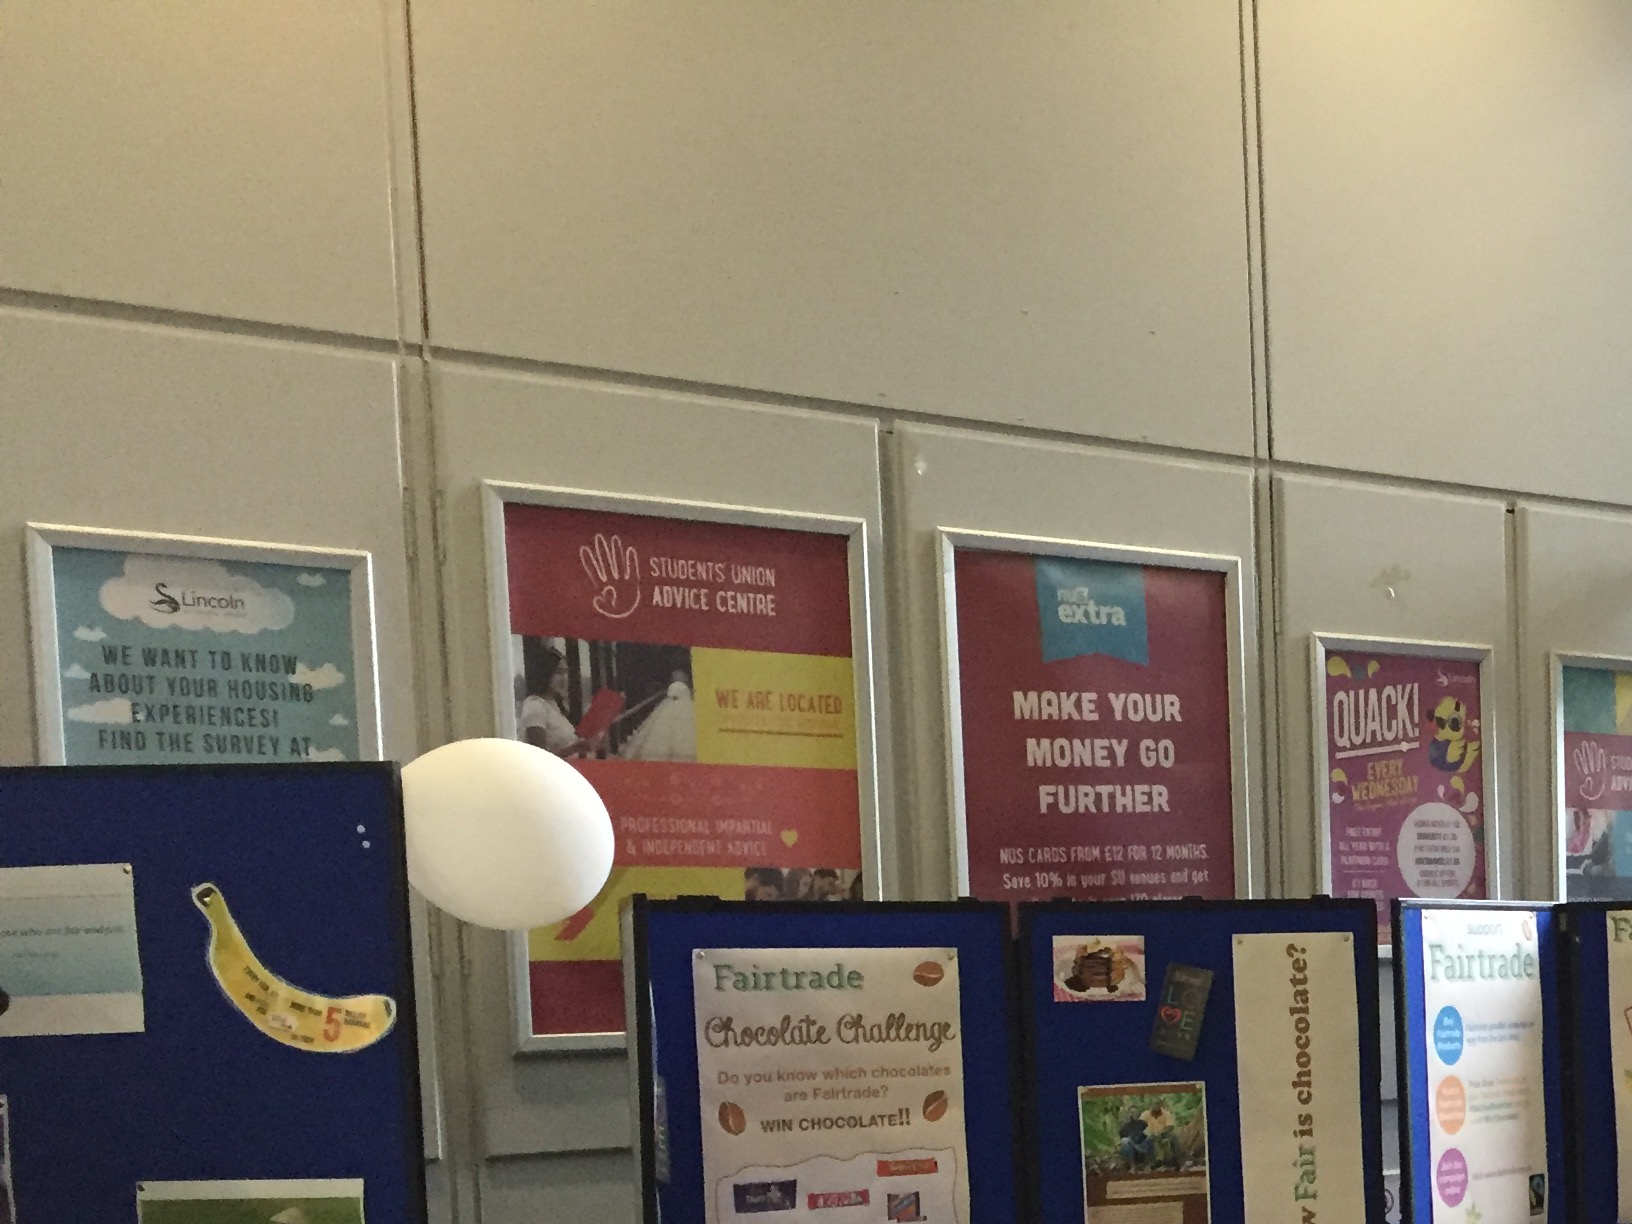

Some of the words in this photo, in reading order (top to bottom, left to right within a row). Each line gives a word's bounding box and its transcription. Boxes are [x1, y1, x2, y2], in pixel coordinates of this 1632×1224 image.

[731, 567, 776, 588] UNION
[181, 591, 245, 610] Lincoln
[652, 585, 710, 611] ADVICE
[716, 591, 776, 616] CENTRE
[1058, 602, 1127, 627] extra
[102, 645, 132, 665] WE
[142, 647, 198, 669] WANT
[208, 651, 232, 671] TO
[241, 652, 298, 675] KNOW
[89, 672, 156, 696] ABOUT
[167, 677, 218, 698] YOUR
[228, 679, 314, 703] HOUSING
[131, 702, 279, 728] EXPERIENCES!
[715, 689, 739, 710] WE
[749, 690, 773, 711] ARE
[779, 692, 844, 715] LOCATED
[1012, 690, 1099, 722] MAKE
[1108, 692, 1183, 723] YOUR
[1334, 682, 1420, 748] QUACK!
[98, 729, 146, 751] FIND
[156, 731, 194, 753] THE
[202, 733, 280, 756] SURVEY
[289, 736, 312, 757] AT
[1026, 737, 1128, 768] MONEY
[1139, 739, 1175, 768] GO
[1366, 759, 1404, 780] EVERY
[1039, 784, 1170, 814] FURTHER
[642, 838, 722, 856] INDEPENDENT
[1000, 847, 1024, 865] NUS
[1028, 847, 1068, 864] CARDS
[1070, 846, 1100, 863] FROM
[1127, 845, 1147, 862] FOR
[1151, 845, 1162, 860] 12
[1003, 873, 1031, 889] Save
[1036, 871, 1063, 888] 10%
[1081, 873, 1105, 888] your
[1110, 870, 1126, 885] SU
[1170, 867, 1188, 884] and
[1467, 923, 1503, 936] support
[1428, 943, 1534, 982] Fairtrade
[713, 963, 865, 992] Fairtrade
[323, 1006, 343, 1042] 5
[704, 1014, 831, 1048] Chocolate
[836, 1012, 956, 1053] Challenge
[1286, 943, 1313, 1106] chocolate?
[718, 1070, 739, 1086] Do
[744, 1070, 773, 1087] you
[777, 1066, 818, 1083] know
[822, 1065, 867, 1082] which
[871, 1064, 951, 1080] chocolates
[784, 1089, 808, 1103] are
[812, 1084, 889, 1101] Fairtrade?
[760, 1118, 793, 1133] WIN
[798, 1107, 912, 1132] CHOCOLATE!!
[1293, 1113, 1314, 1139] is
[1292, 1145, 1317, 1203] Fair
